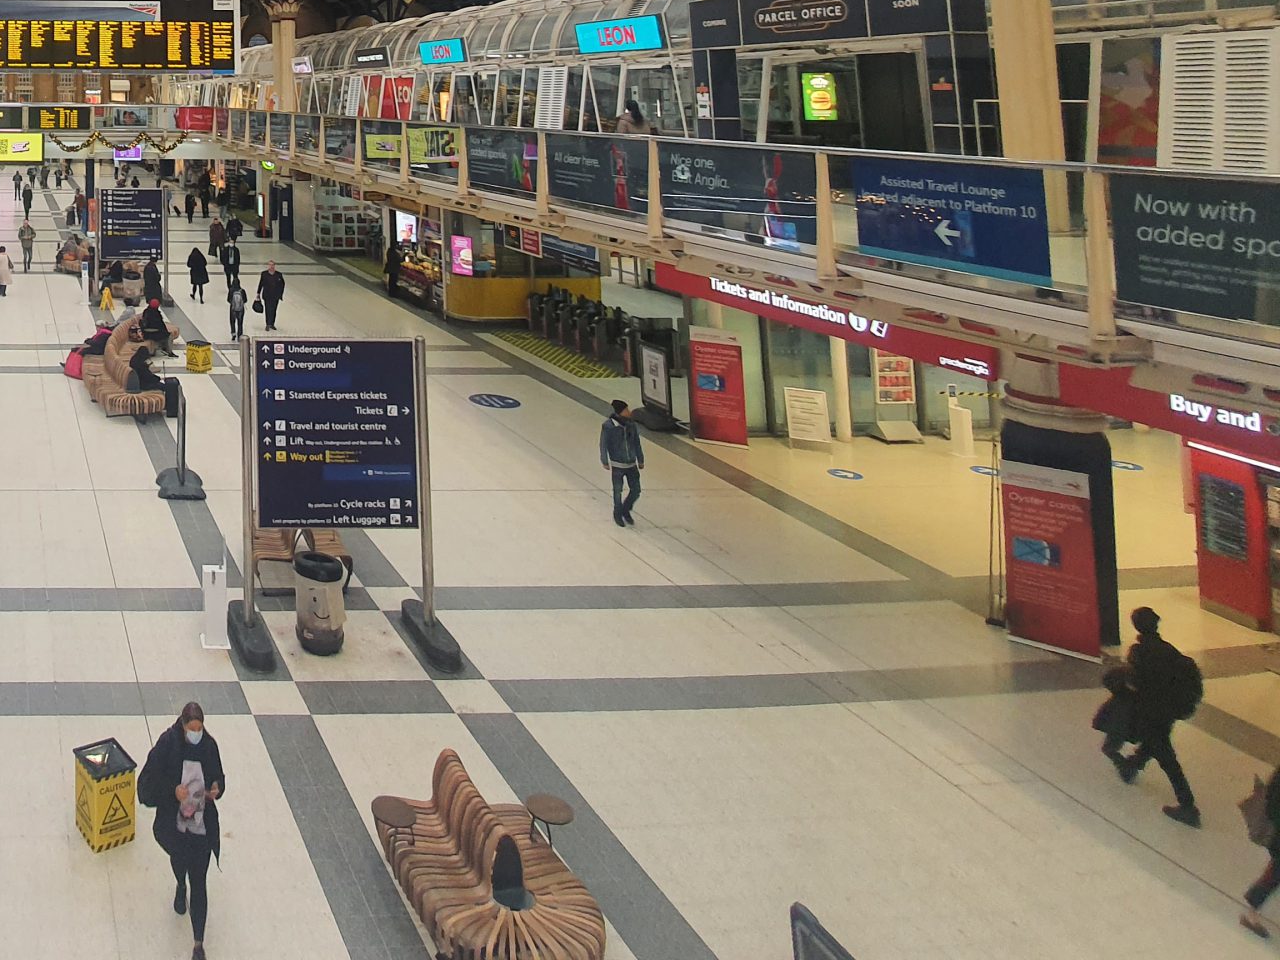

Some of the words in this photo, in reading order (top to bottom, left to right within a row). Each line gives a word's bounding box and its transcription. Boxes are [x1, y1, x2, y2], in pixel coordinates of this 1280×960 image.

[758, 11, 797, 23] PARCEL
[801, 5, 842, 19] OFFICE
[598, 25, 636, 46] LEON
[431, 44, 451, 60] LEON
[554, 152, 563, 162] All
[563, 153, 582, 164] clear
[582, 155, 601, 168] here.
[671, 153, 692, 166] Nice
[693, 158, 716, 172] one,
[694, 173, 730, 190] Anglia.
[880, 176, 924, 189] Assisted
[926, 179, 958, 193] Travel
[961, 182, 1006, 199] Lounge
[901, 194, 946, 209] adjacent
[949, 200, 962, 210] to
[964, 200, 1017, 217] Platform
[1020, 206, 1037, 219] 10
[1134, 193, 1190, 217] Now
[1199, 200, 1256, 223] with
[1137, 224, 1224, 250] added
[709, 276, 747, 299] Tickets
[748, 289, 771, 305] and
[772, 292, 846, 326] information
[288, 345, 341, 355] Underground
[288, 360, 336, 370] Overground
[289, 391, 325, 400] Stansted
[327, 391, 358, 401] Express
[360, 391, 387, 400] tickets
[355, 406, 384, 415] Tickets
[1169, 394, 1212, 423] Buy
[1216, 409, 1261, 432] and
[289, 422, 313, 431] Travel
[314, 422, 329, 431] and
[331, 422, 359, 431] tourist
[360, 423, 387, 431] centre
[290, 437, 304, 446] Lift
[290, 452, 308, 462] Way
[309, 453, 323, 461] out
[340, 499, 363, 510] Cycle
[364, 499, 386, 508] racks
[1008, 491, 1046, 507] Oyster
[333, 515, 350, 524] Left
[352, 515, 386, 525] Luggage
[99, 780, 131, 795] CAUTION
